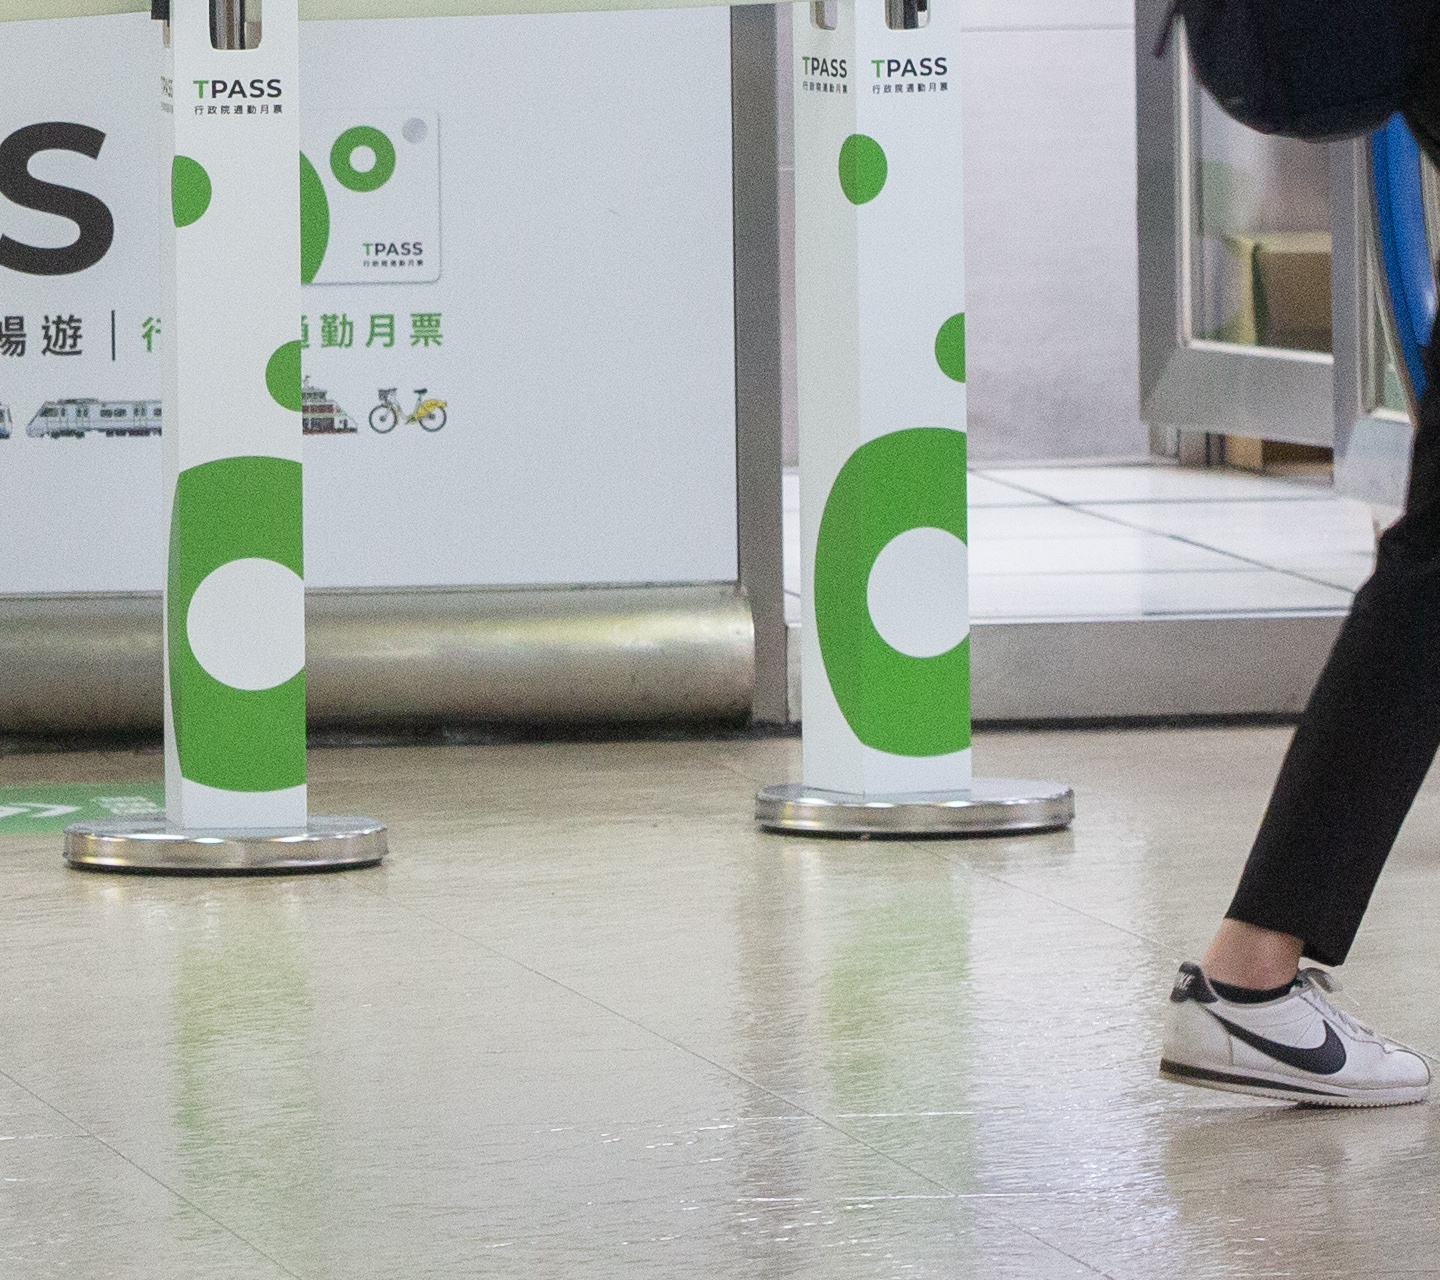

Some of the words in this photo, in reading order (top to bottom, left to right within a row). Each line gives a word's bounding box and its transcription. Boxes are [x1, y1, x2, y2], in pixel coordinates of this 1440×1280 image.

[802, 56, 848, 79] TPASS
[871, 57, 948, 78] TPASS
[193, 78, 283, 99] TPASS
[872, 81, 949, 95] 行政院通勤月票
[194, 104, 283, 115] 行政院通勤月票
[363, 242, 424, 257] TPASS
